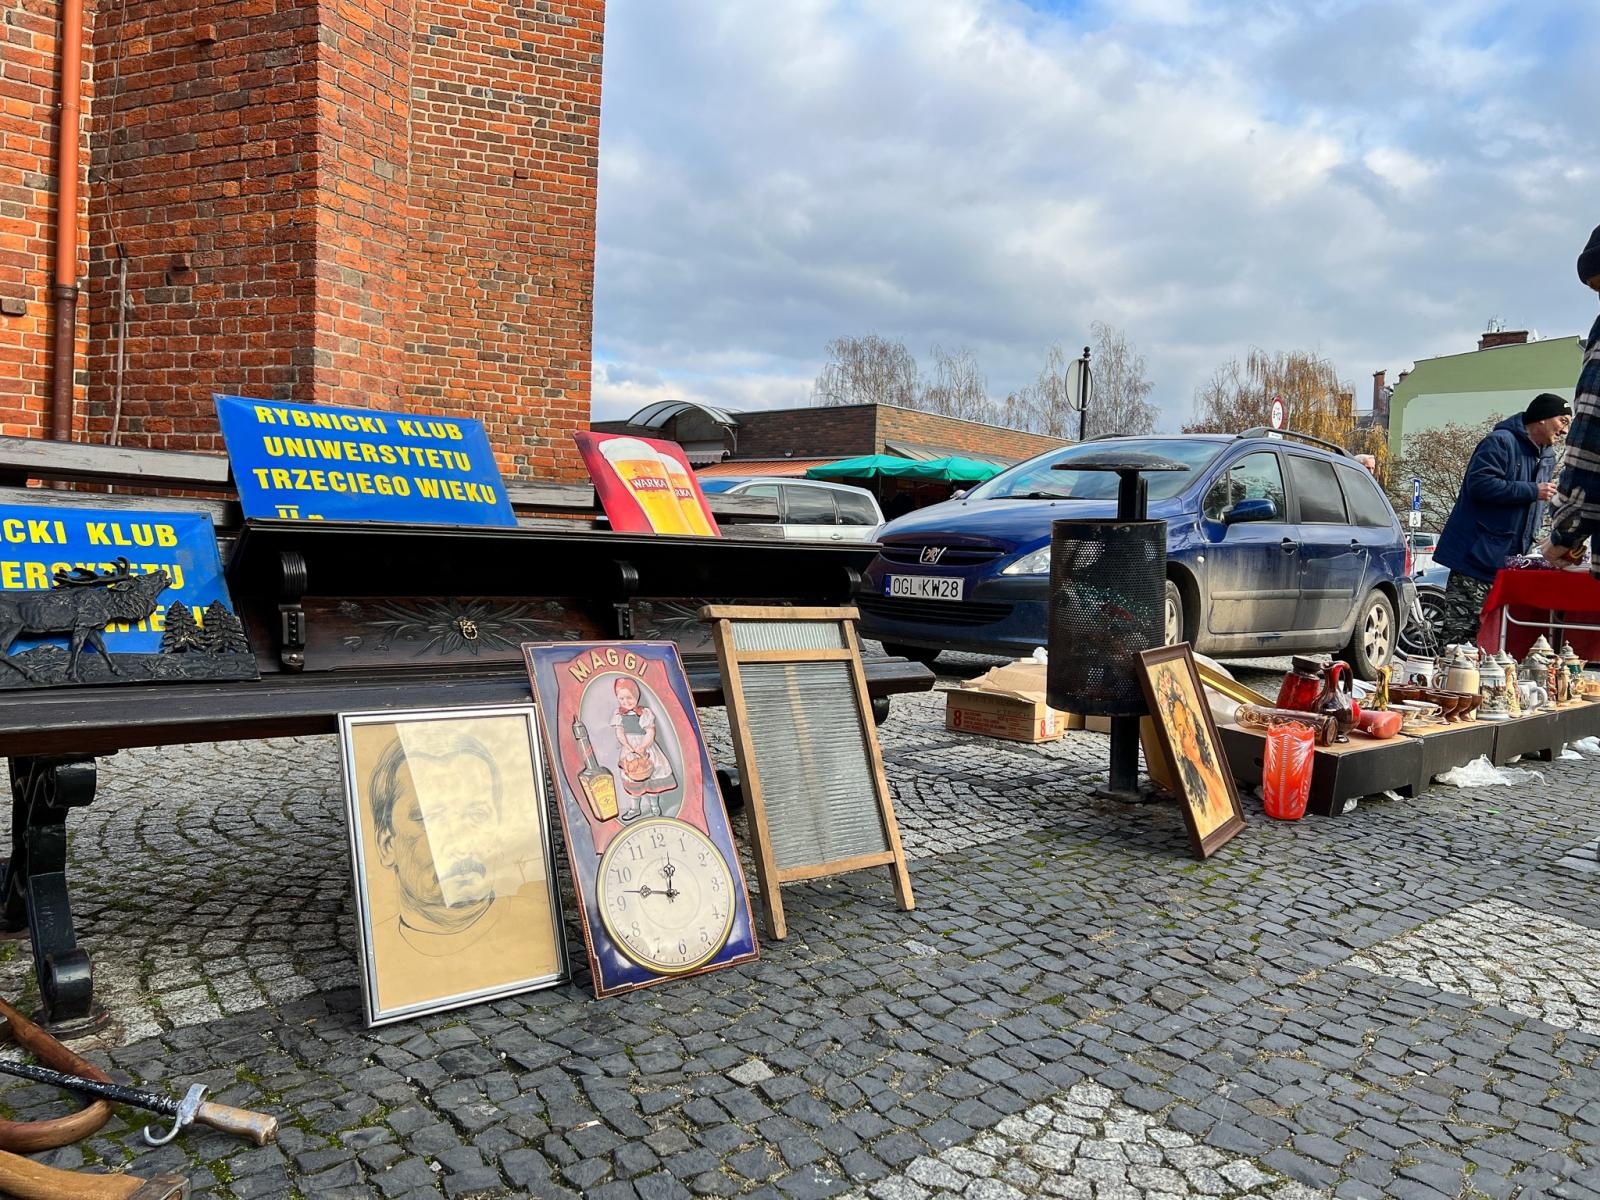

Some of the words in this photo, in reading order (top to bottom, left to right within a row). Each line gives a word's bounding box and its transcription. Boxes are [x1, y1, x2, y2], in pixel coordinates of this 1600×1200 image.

[254, 405, 388, 434] RYBNICKI
[397, 419, 464, 440] KLUB
[263, 436, 471, 471] UNIWERSYTETU
[252, 468, 411, 497] TRZECIEGO
[414, 476, 497, 505] WIEKU
[631, 479, 668, 489] WARKA
[0, 518, 67, 544] CKI
[86, 521, 179, 547] KLUB
[893, 578, 917, 595] OGL
[921, 579, 959, 598] KW28
[568, 648, 649, 684] MAGGI
[954, 710, 962, 727] 8
[1040, 719, 1046, 738] 8
[650, 832, 667, 849] 12
[679, 838, 686, 852] 1
[628, 845, 644, 861] 11
[698, 853, 707, 867] 2
[616, 866, 632, 884] 10
[711, 877, 720, 892] 3
[616, 895, 627, 912] 9
[712, 904, 720, 920] 4
[631, 920, 642, 938] 8
[699, 926, 708, 943] 5
[653, 937, 661, 954] 7
[678, 939, 687, 955] 6
